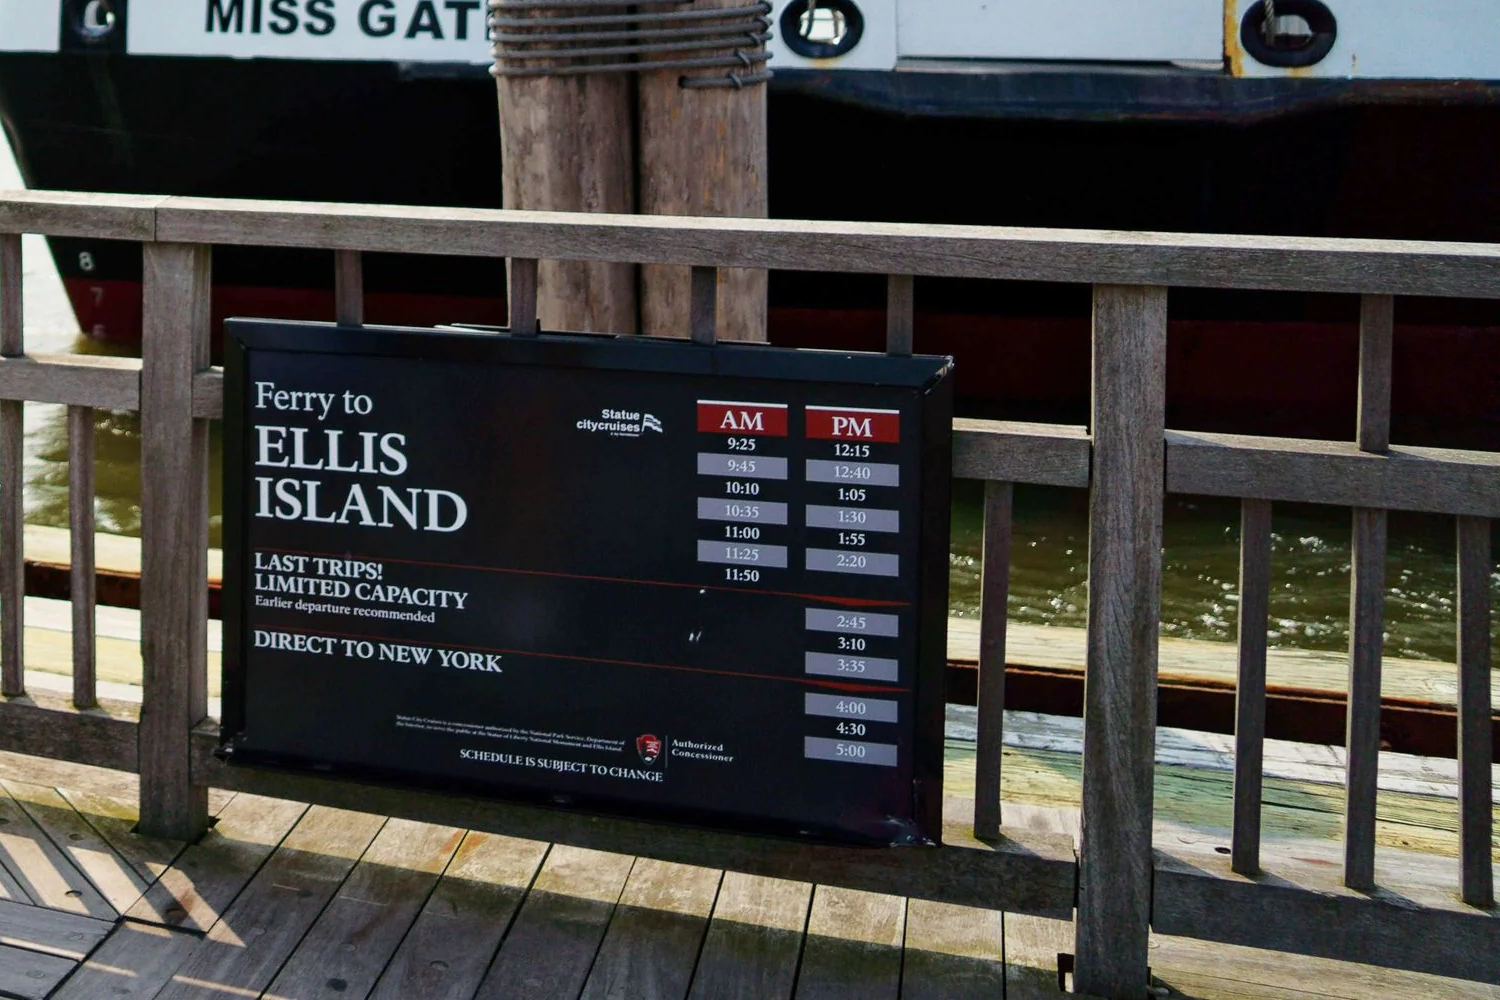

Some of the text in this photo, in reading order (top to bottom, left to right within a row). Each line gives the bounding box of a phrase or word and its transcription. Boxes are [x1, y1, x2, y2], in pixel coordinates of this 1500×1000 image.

[78, 251, 95, 272] 8
[254, 381, 373, 421] Ferry to
[601, 408, 640, 421] Statue
[720, 410, 764, 431] AM
[576, 418, 641, 433] citycruises
[831, 416, 873, 438] PM
[254, 425, 408, 476] ELLIS
[727, 437, 756, 451] 9:25
[834, 443, 870, 457] 12:15
[727, 459, 756, 473] 9:45
[834, 465, 871, 480] 12:40
[725, 481, 760, 495] 10:10
[838, 488, 866, 501] 1:05
[254, 476, 468, 532] ISLAND
[725, 504, 759, 518] 10:35
[838, 510, 866, 524] 1:30
[725, 526, 760, 539] 11:00
[838, 532, 866, 546] 1:55
[725, 547, 759, 561] 11:25
[836, 554, 866, 568] 2:20
[254, 552, 384, 581] LAST TRIPS!
[725, 568, 760, 582] 11:50
[254, 573, 468, 610] LIMITED CAPACITY
[255, 595, 436, 623] Earlier departure recommended
[836, 615, 866, 629] 2:45
[837, 636, 866, 651] 3:10
[254, 630, 503, 673] DIRECT TO NEW YORK
[837, 658, 865, 672] 3:35
[835, 700, 866, 715] 4:00
[835, 722, 866, 736] 4:30
[671, 739, 724, 752] Authorized
[835, 743, 866, 758] 5:00
[671, 748, 734, 762] Concessioner
[459, 749, 664, 783] SCHEDULE IS SUBJECT TO CHANGE
